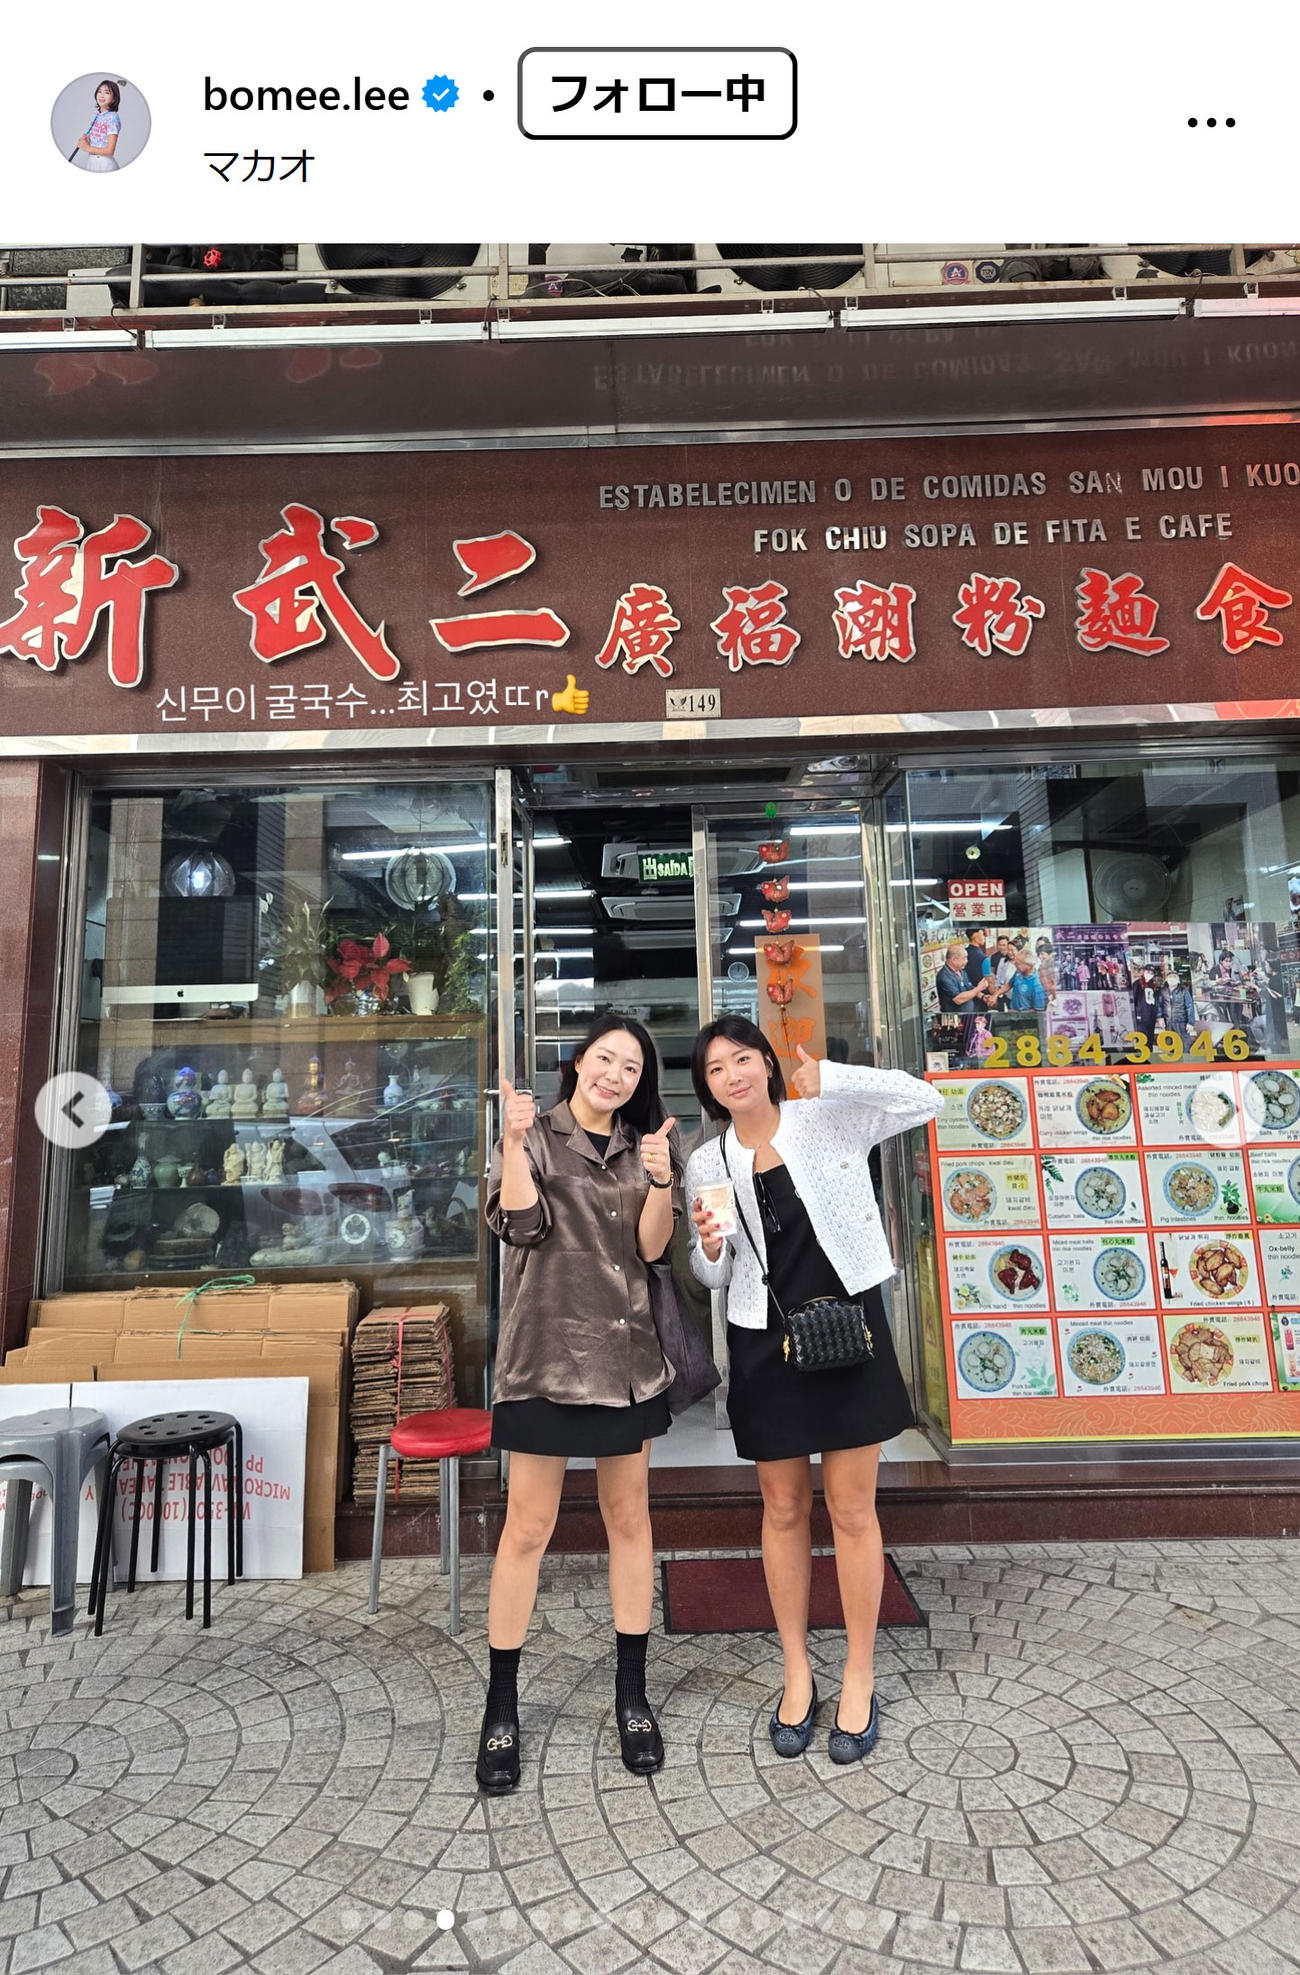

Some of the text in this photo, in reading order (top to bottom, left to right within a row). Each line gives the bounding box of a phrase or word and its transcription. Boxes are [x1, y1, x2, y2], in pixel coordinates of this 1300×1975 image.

[834, 478, 852, 503] O
[872, 476, 905, 501] DE
[923, 472, 1046, 499] COMIDAS
[1069, 470, 1122, 494] SAN
[1141, 466, 1203, 491] MOU
[1220, 465, 1229, 488] I
[1245, 462, 1300, 487] KUO
[754, 512, 1233, 555] FOK CHIU SOPA DE FITA E CAFE
[689, 694, 716, 712] 149
[950, 882, 1003, 897] OPEN
[953, 902, 1003, 918] 營業中
[983, 1029, 1250, 1068] 2884 3946
[245, 1453, 264, 1474] PP
